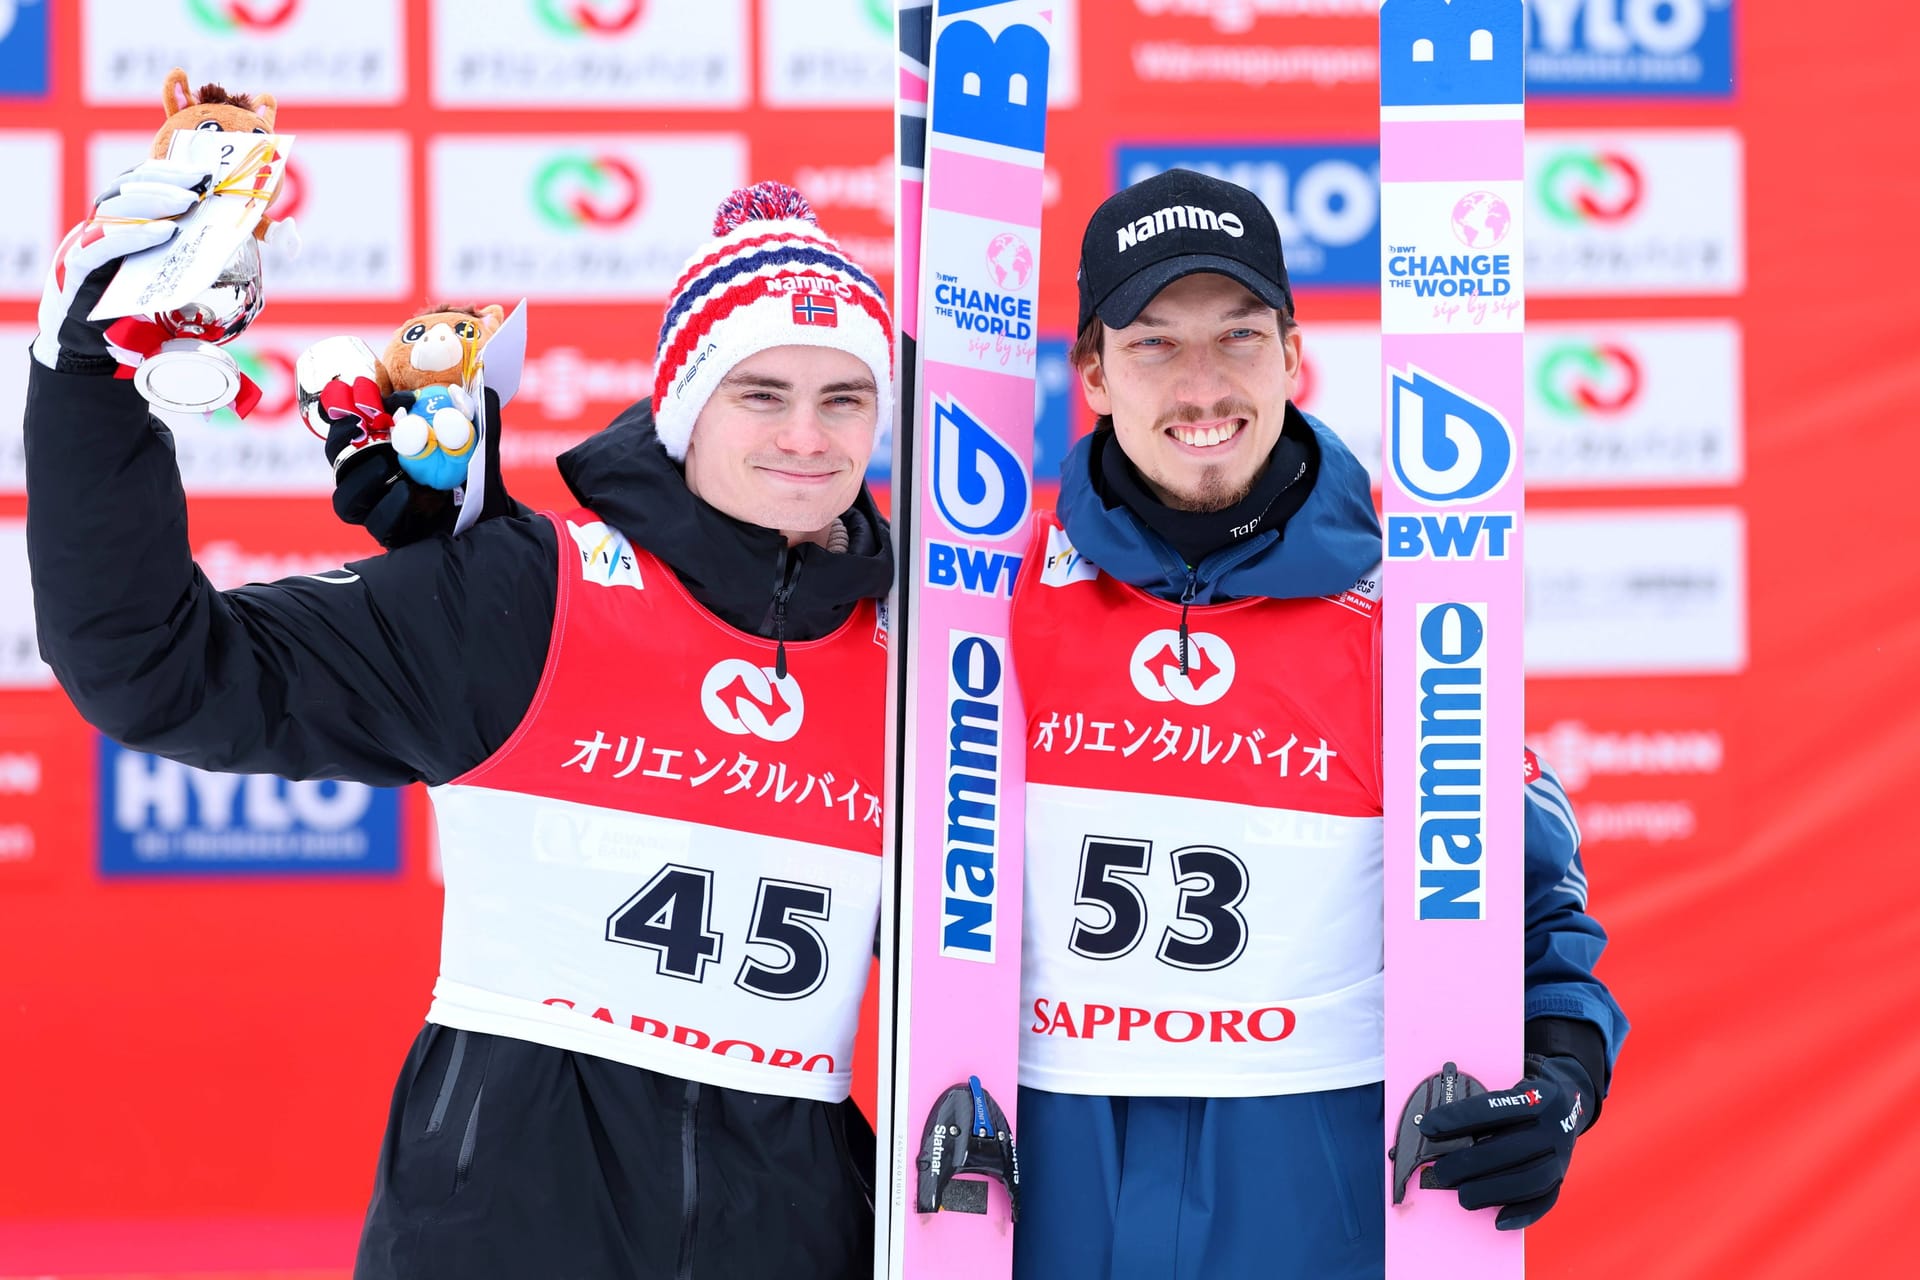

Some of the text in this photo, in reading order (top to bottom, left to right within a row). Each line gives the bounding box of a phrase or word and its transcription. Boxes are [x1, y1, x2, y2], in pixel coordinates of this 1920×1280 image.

[1116, 205, 1244, 253] Nammo
[765, 276, 852, 297] Nammo
[1388, 255, 1510, 277] CHANGE
[1389, 278, 1511, 297] THE WORLD
[935, 284, 1031, 320] CHANGE
[935, 306, 1031, 341] THE WORLD
[1432, 289, 1521, 326] sip by sip
[968, 329, 1036, 366] sip by sip
[676, 343, 717, 399] FIBRA
[1387, 515, 1512, 558] BWT
[582, 550, 632, 570] FIS
[928, 542, 1023, 597] BWT
[1357, 585, 1371, 594] CUP
[1033, 712, 1338, 781] オリエンタルバイオ
[1419, 602, 1483, 920] Nammo
[943, 636, 1001, 952] Nammo
[1068, 834, 1250, 972] 53
[605, 863, 832, 1001] 45
[1032, 997, 1296, 1043] SAPPORO
